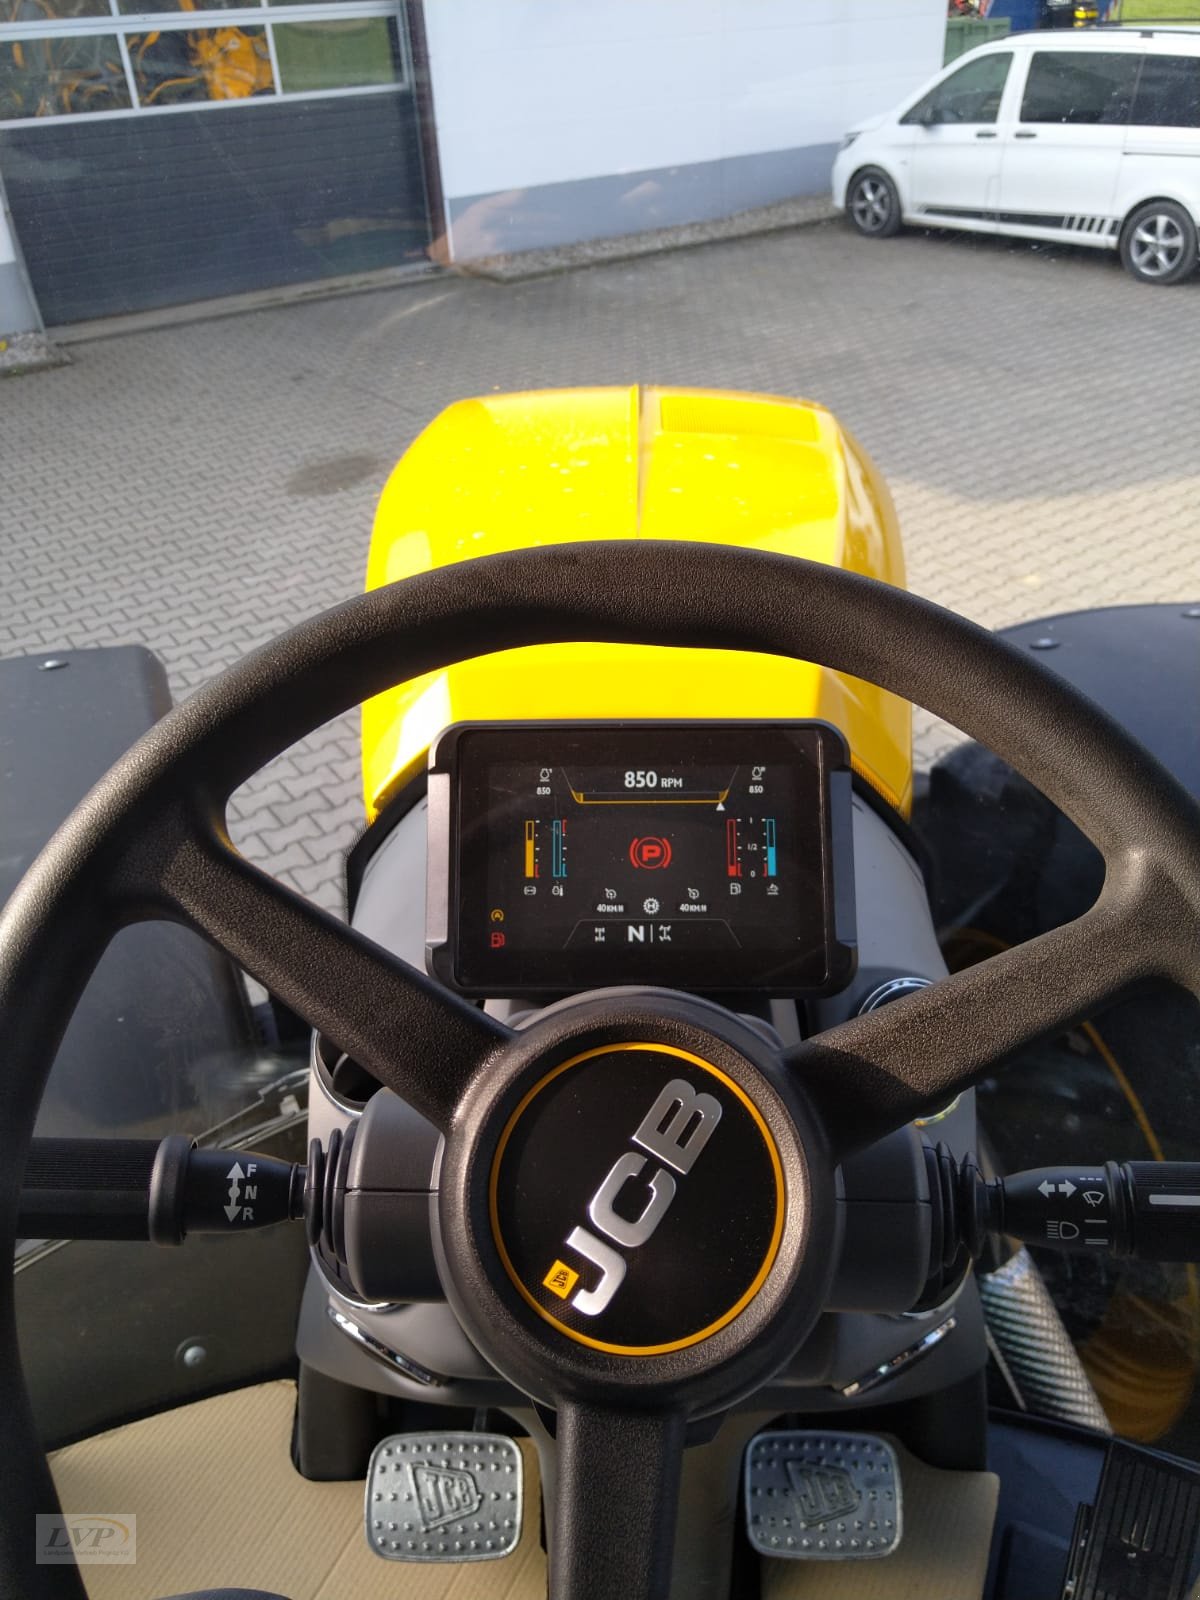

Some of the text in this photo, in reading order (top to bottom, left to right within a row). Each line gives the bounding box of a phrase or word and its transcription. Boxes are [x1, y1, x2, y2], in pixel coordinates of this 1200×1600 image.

[624, 771, 683, 788] 850 RPM
[536, 786, 551, 795] 850
[749, 785, 764, 794] 850
[627, 925, 645, 942] N
[246, 1163, 257, 1178] F
[244, 1185, 258, 1200] N
[564, 1077, 723, 1316] JCB
[242, 1207, 255, 1221] R
[422, 1471, 473, 1520] JCB
